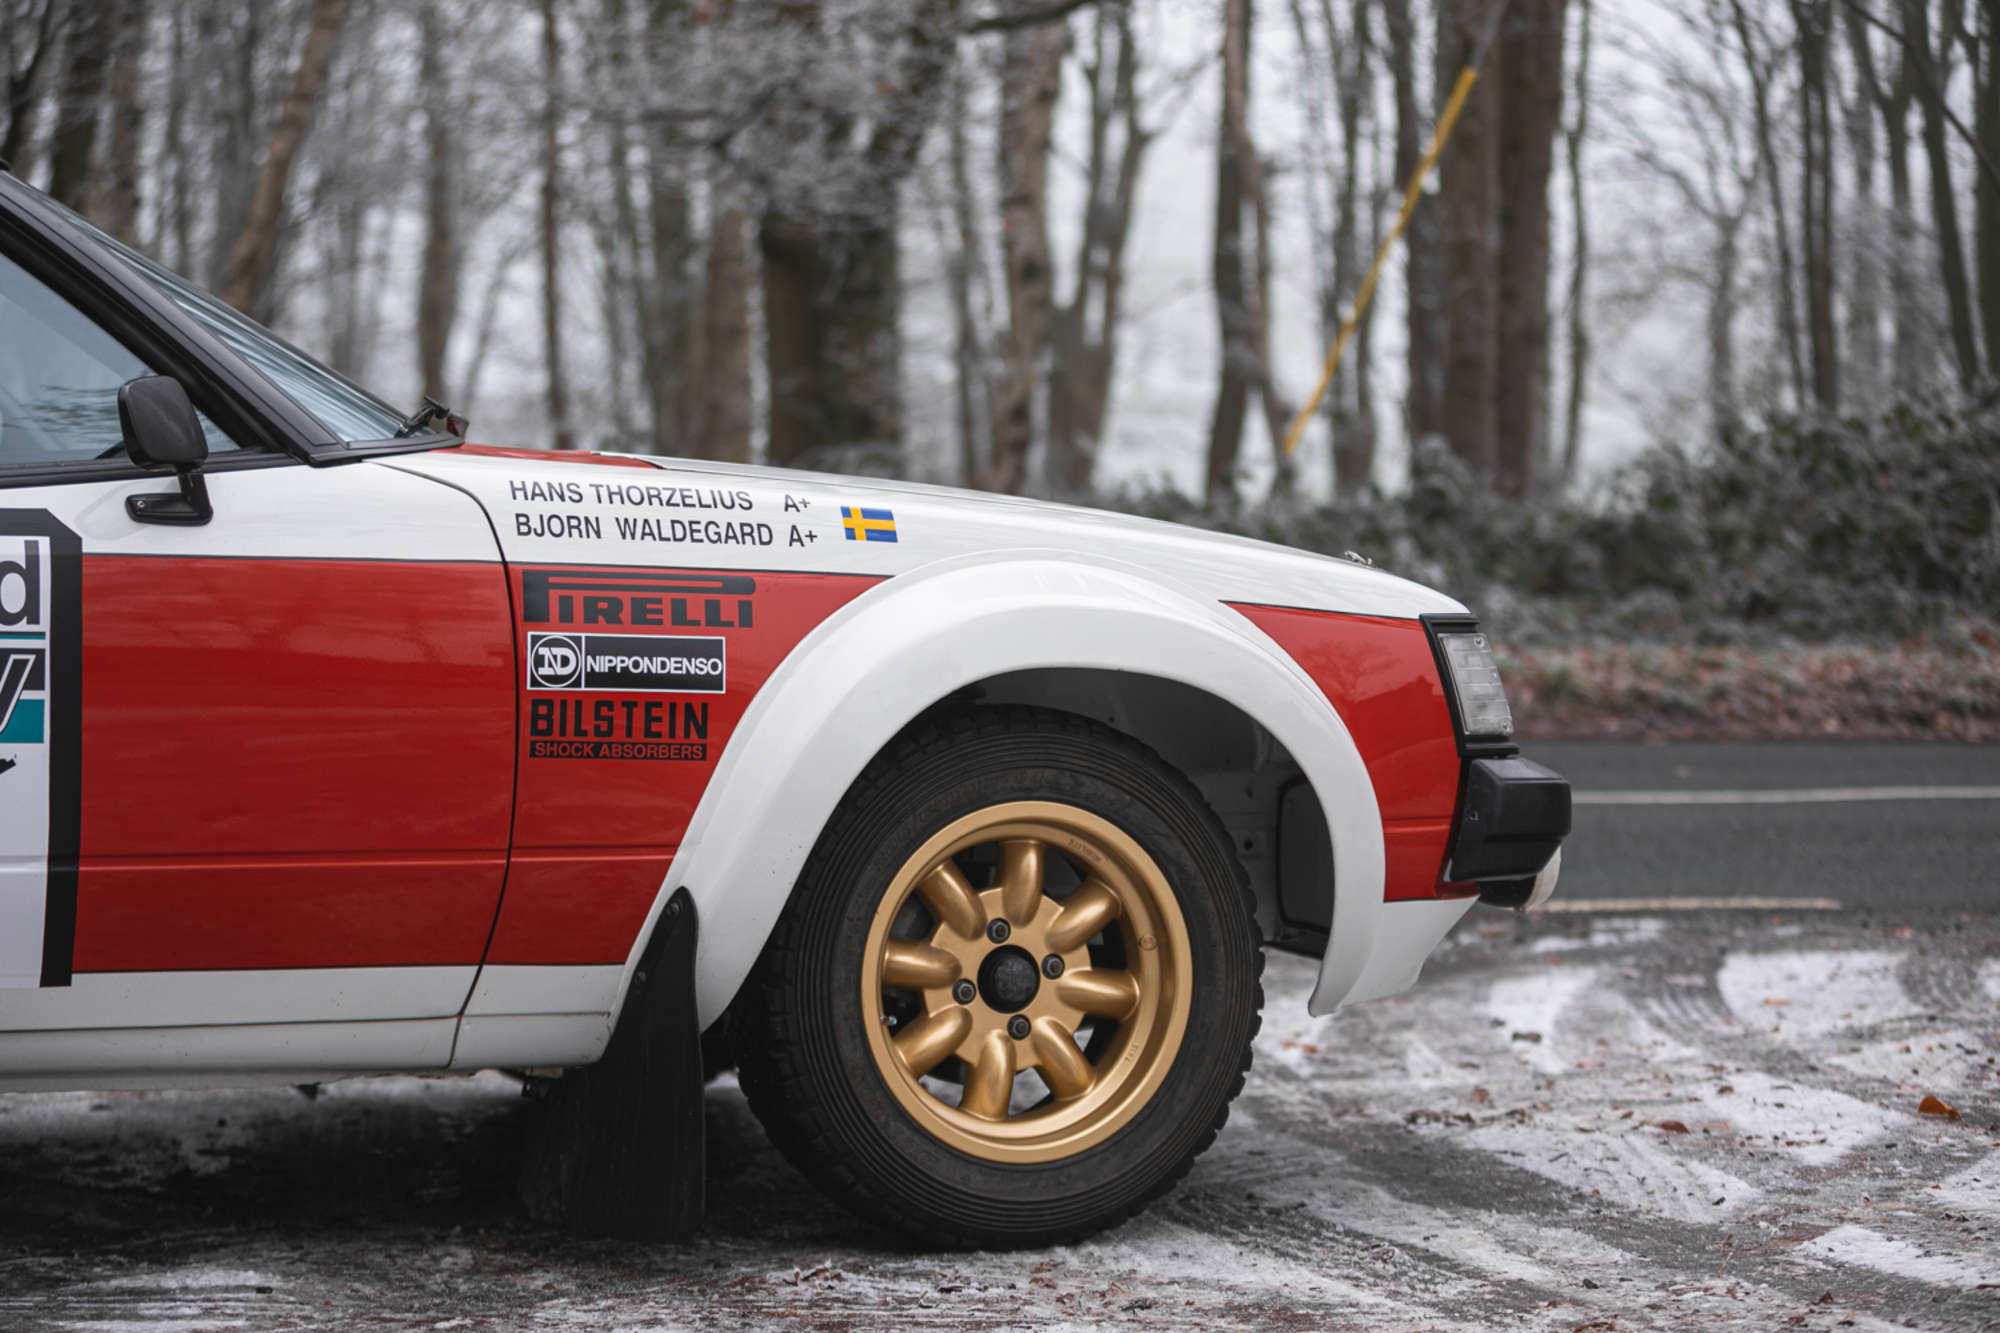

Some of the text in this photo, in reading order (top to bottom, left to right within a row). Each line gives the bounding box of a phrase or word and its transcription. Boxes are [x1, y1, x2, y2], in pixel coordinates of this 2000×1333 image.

[509, 480, 811, 513] HANS THORZELIUS A+
[515, 513, 818, 547] BJORN WALDEGARD A+
[522, 569, 756, 628] PIRELLI
[586, 655, 722, 676] NIPPONDENSO
[530, 698, 708, 739] BILSTEIN
[534, 742, 703, 760] SHOCK ABSORBERS
